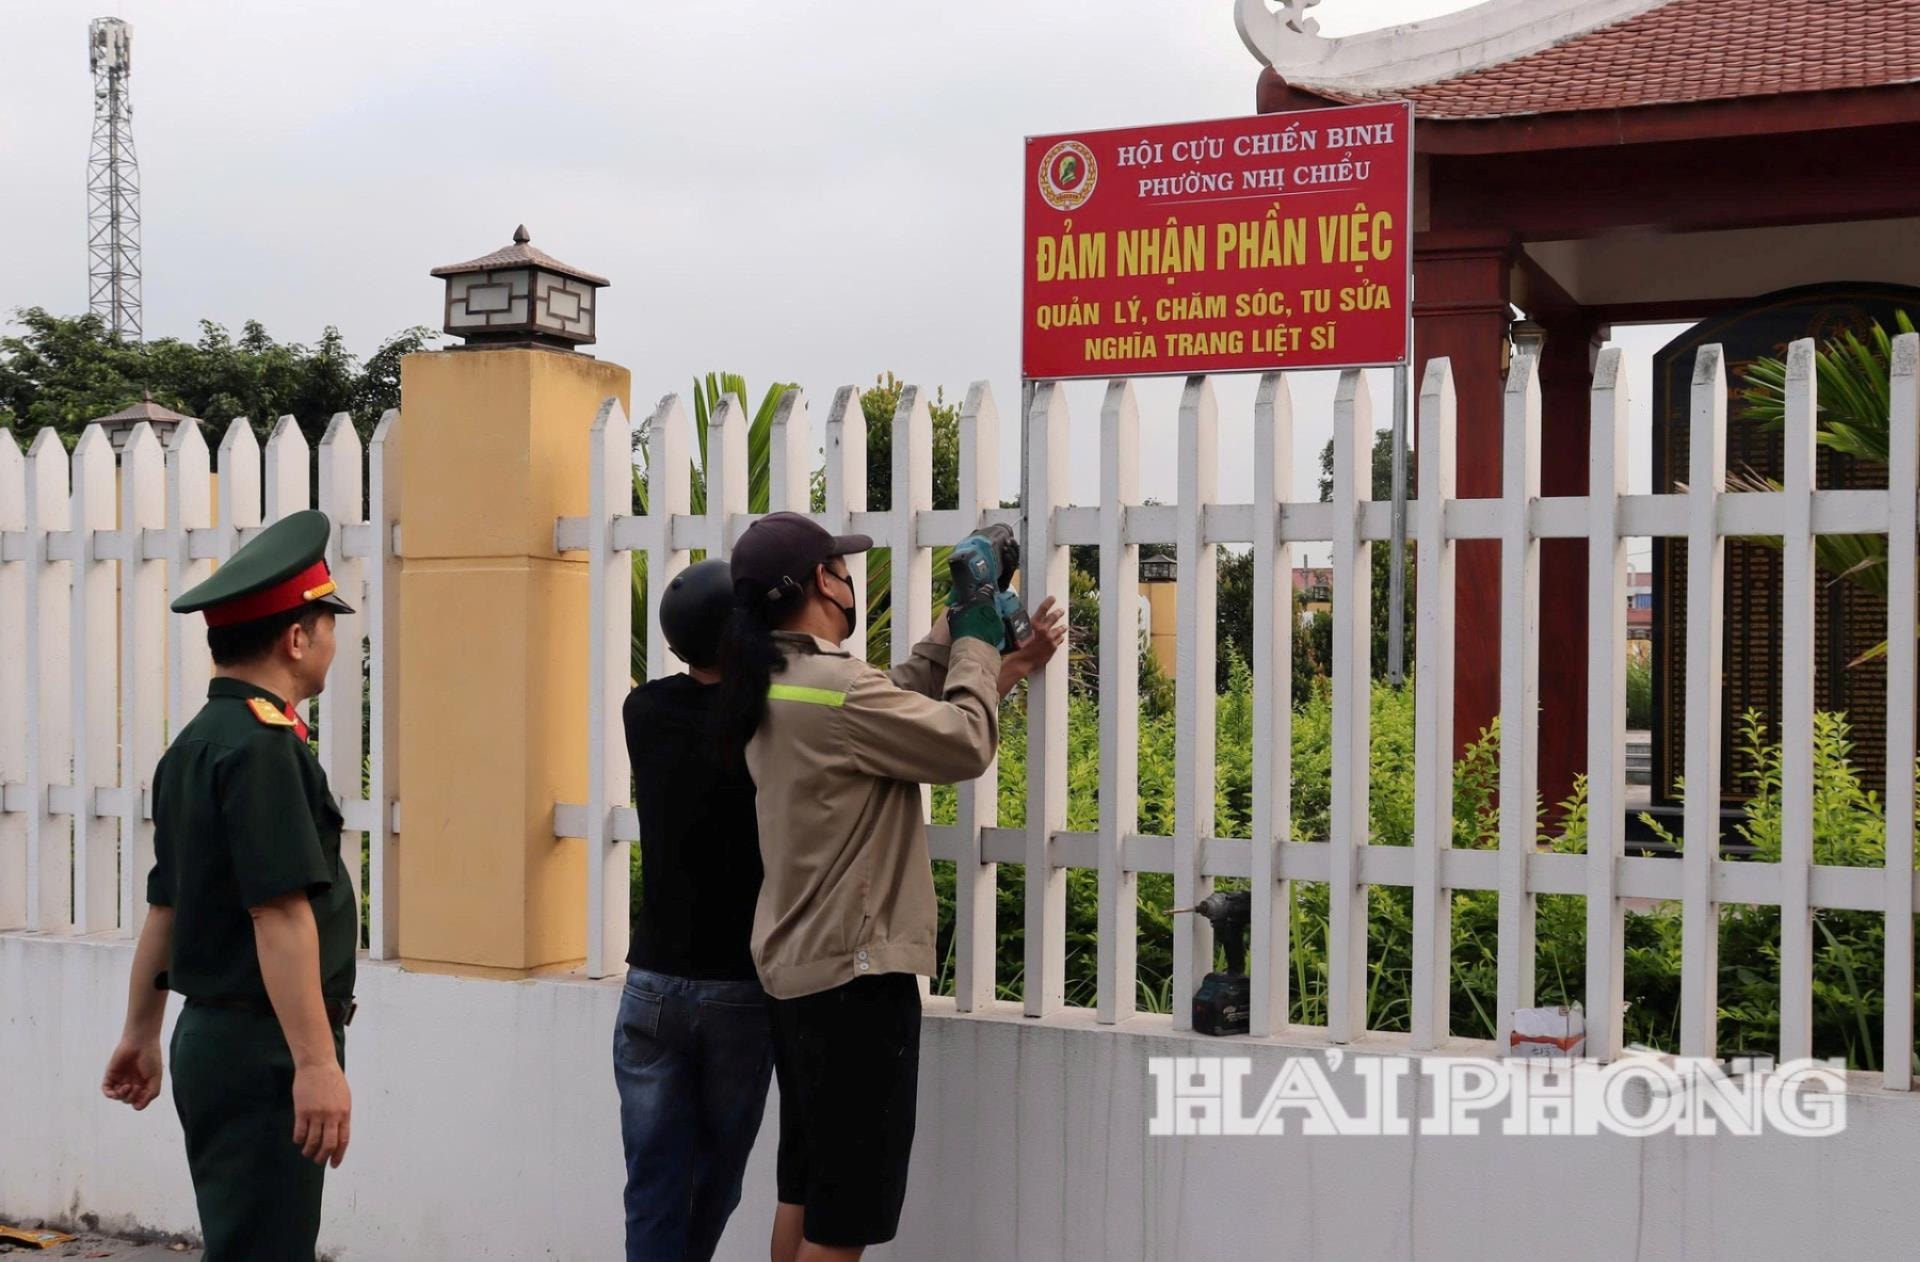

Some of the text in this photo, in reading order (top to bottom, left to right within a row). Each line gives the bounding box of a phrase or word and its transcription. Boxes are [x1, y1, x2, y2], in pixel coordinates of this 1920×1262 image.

[1117, 121, 1394, 168] HỘI CỰU CHIẾN BINH
[1138, 151, 1371, 197] PHƯỜNG NHỊ CHIỂU
[1036, 201, 1393, 284] ĐẢM NHẬN PHẦN VIỆC
[1036, 278, 1391, 328] QUẢN LÝ, CHĂM SÓC, TU SỬA
[1084, 320, 1336, 361] NGHĨA TRANG LIỆT SĨ
